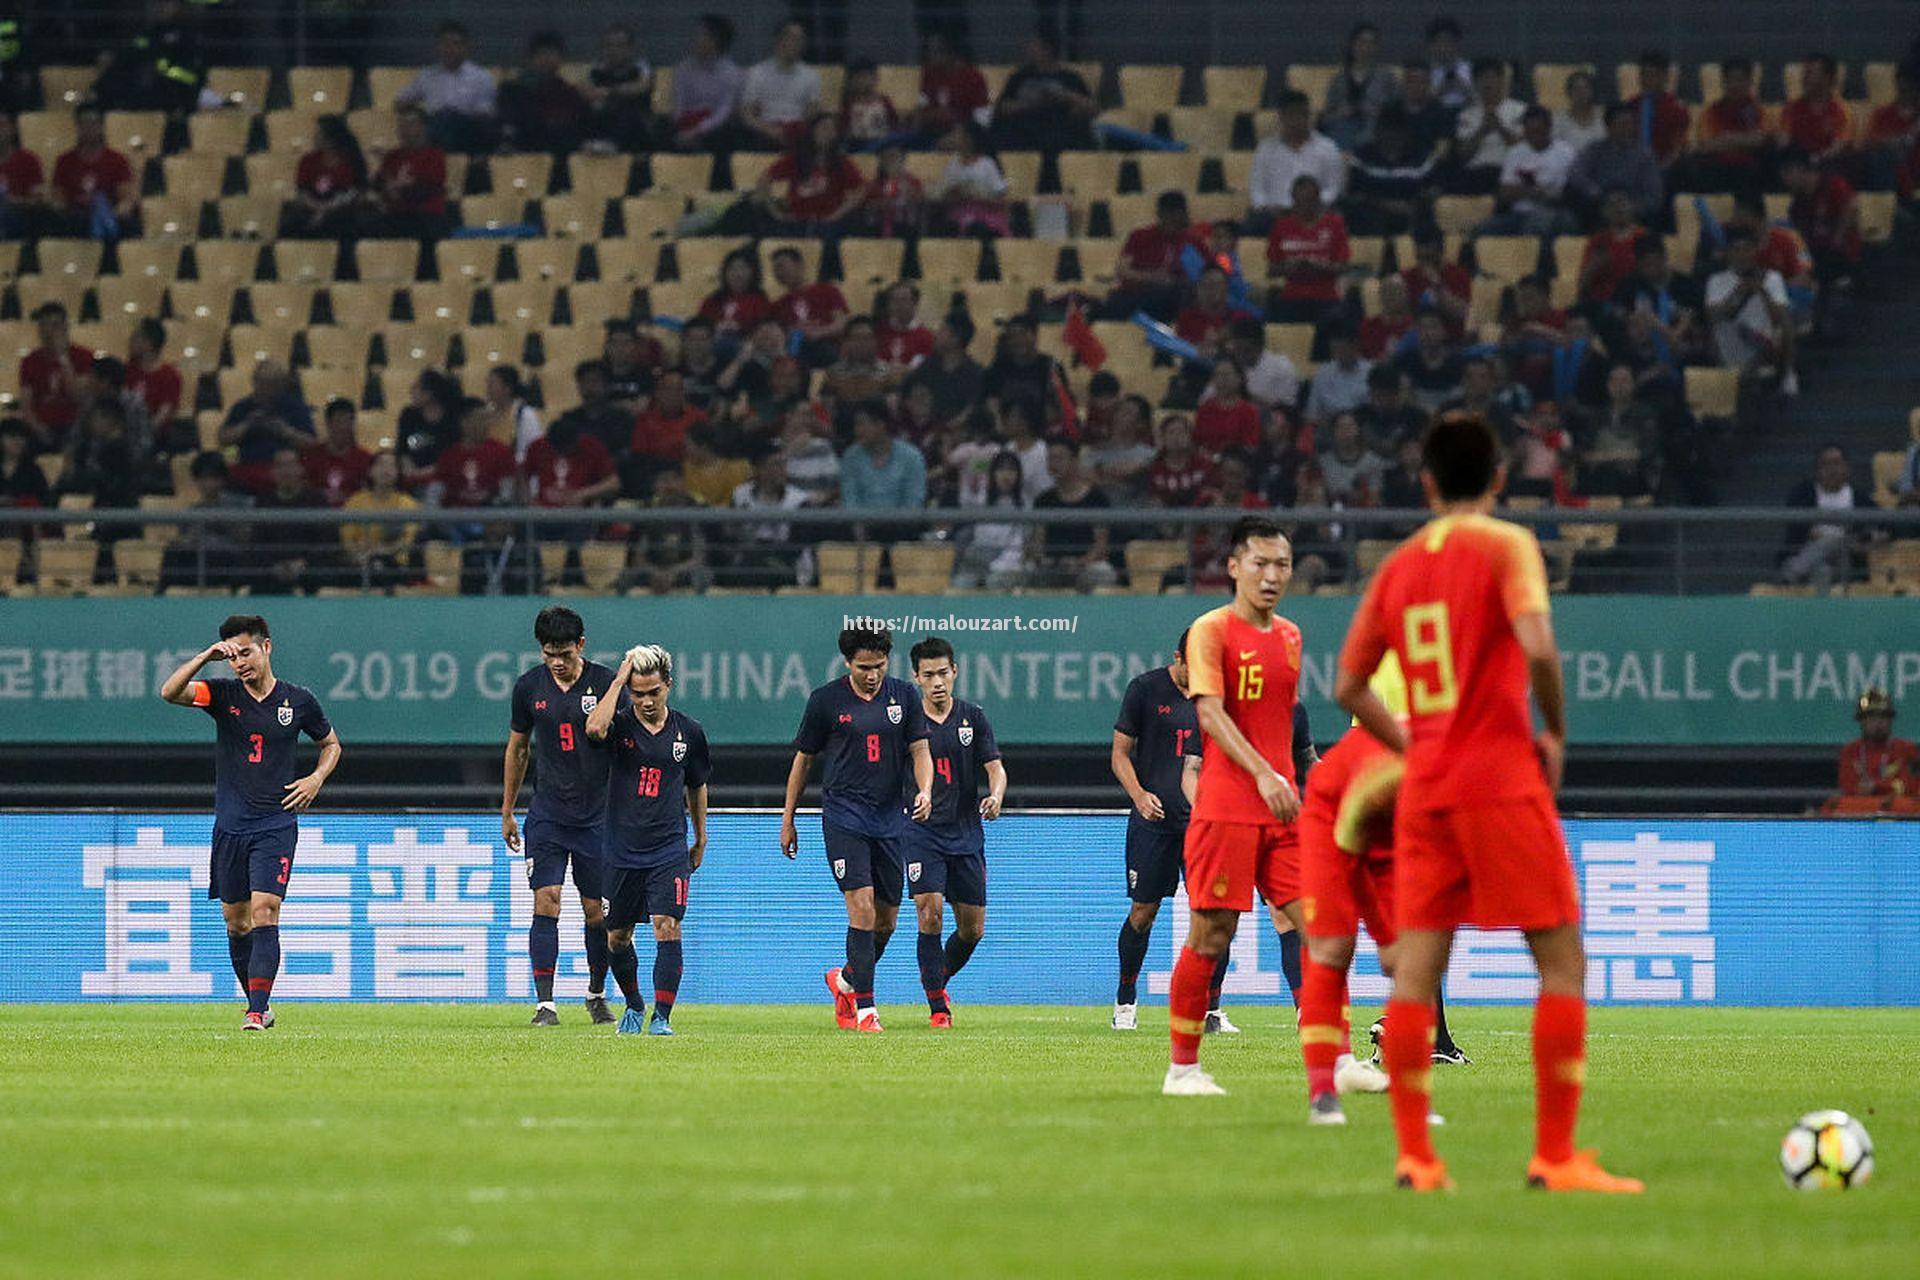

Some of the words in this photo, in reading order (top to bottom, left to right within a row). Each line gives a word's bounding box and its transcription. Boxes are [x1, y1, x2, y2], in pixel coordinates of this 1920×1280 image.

[1404, 601, 1459, 714] 9
[329, 652, 458, 699] 2019
[677, 652, 813, 700] HINA
[1238, 665, 1264, 700] 15
[248, 734, 264, 763] 3
[560, 723, 574, 751] 9
[866, 734, 881, 762] 8
[638, 766, 662, 797] 18
[936, 757, 952, 784] 4
[277, 856, 291, 884] 3
